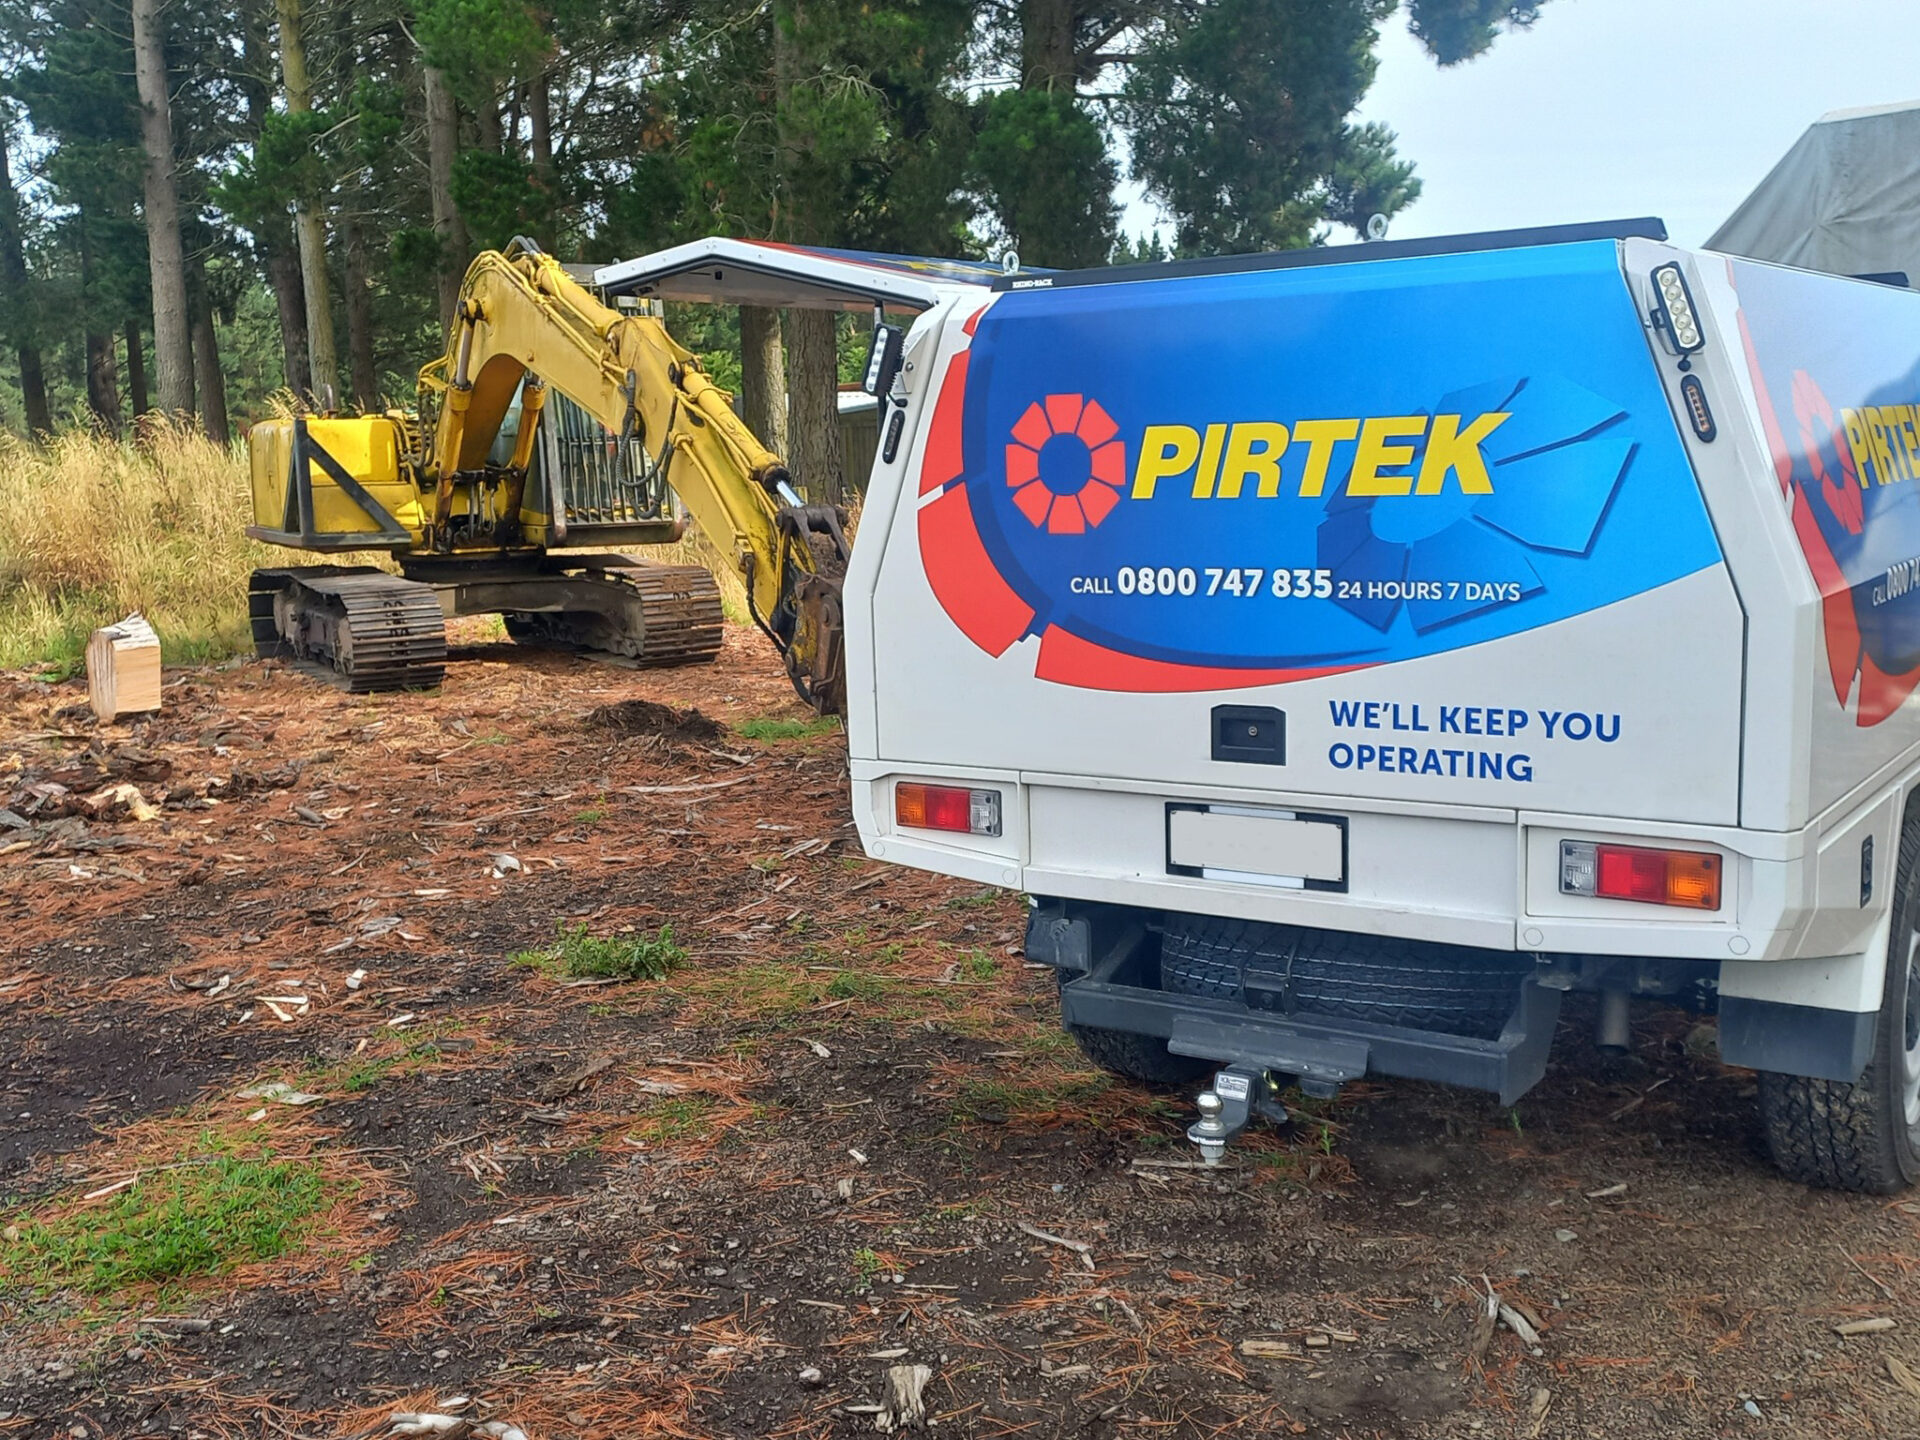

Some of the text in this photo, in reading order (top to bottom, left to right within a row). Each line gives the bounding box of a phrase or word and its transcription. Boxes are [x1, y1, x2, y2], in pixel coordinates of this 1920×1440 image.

[1131, 411, 1514, 499] PIRTEK
[1070, 566, 1521, 602] CALL 0800 747 835 24 HOURS 7 DAYS
[1887, 562, 1910, 601] 0800
[1329, 700, 1621, 743] WE'LL KEEP YOU
[1329, 742, 1533, 782] OPERATING
